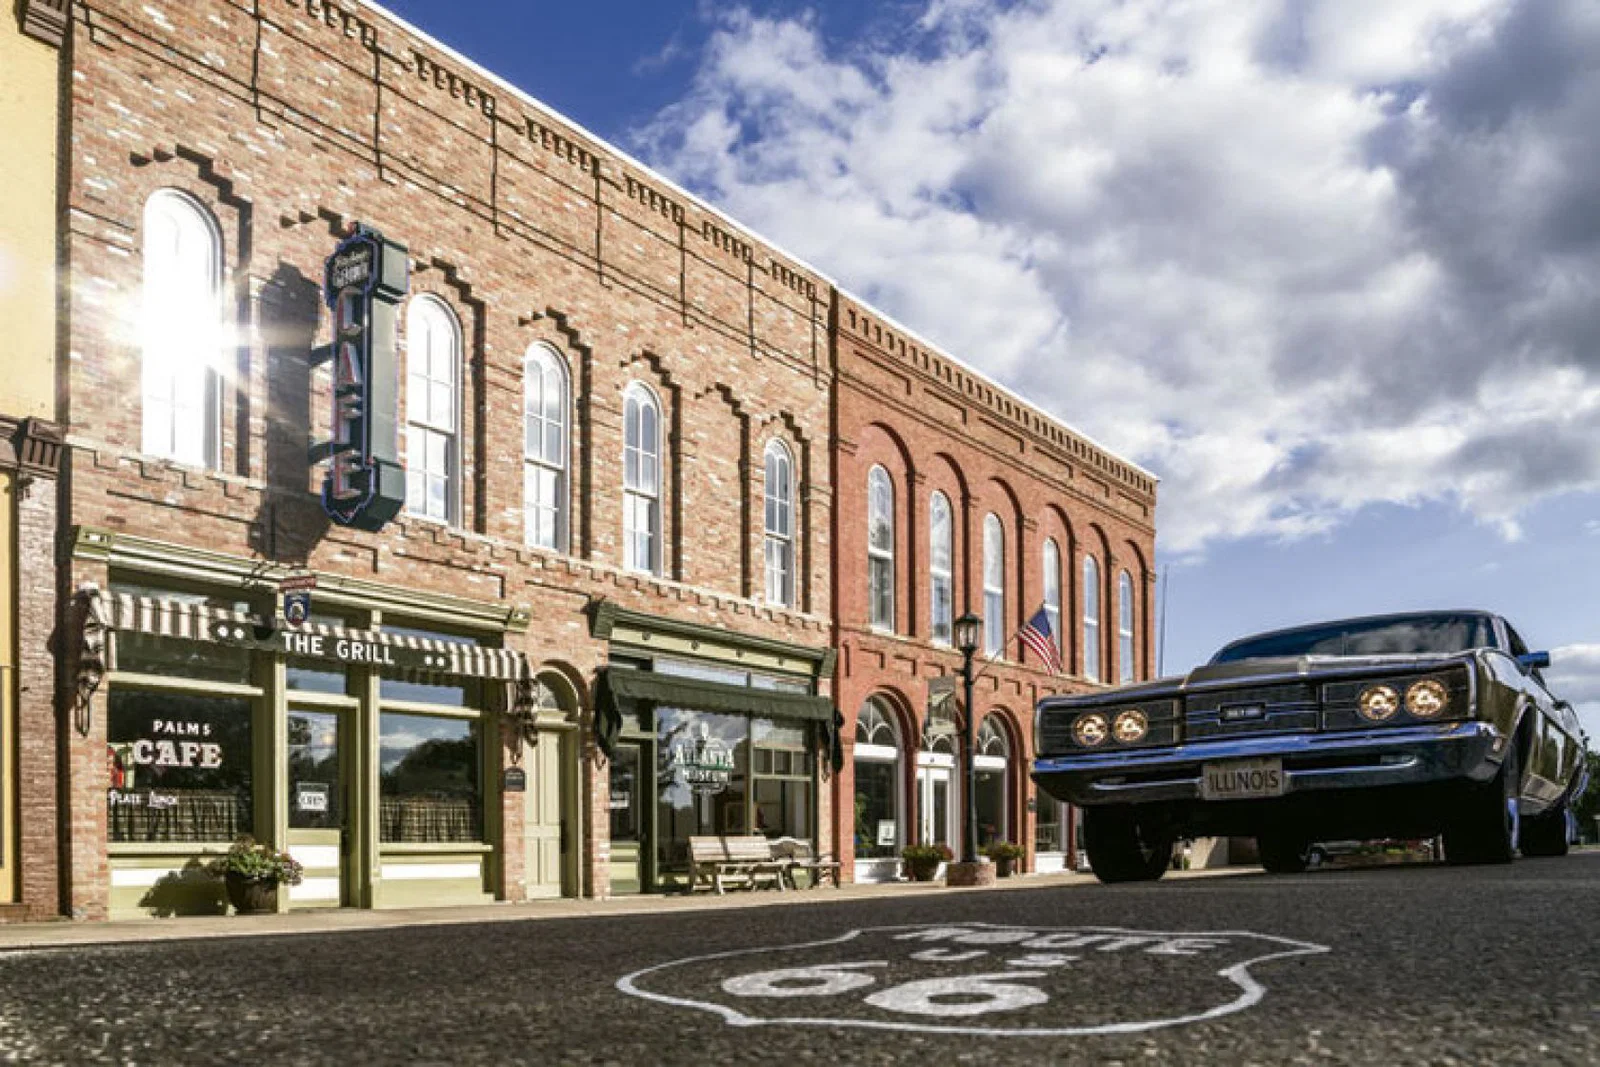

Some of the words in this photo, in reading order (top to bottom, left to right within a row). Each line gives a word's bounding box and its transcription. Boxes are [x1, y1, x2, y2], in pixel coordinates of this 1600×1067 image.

[332, 285, 364, 500] CAFE
[281, 631, 325, 656] THE
[336, 639, 395, 665] GRILL
[152, 719, 212, 736] PALMS
[133, 738, 223, 769] CAFE
[673, 744, 735, 769] ATLANTA
[1208, 769, 1279, 793] ILLINOIS
[720, 960, 1050, 1017] 66
